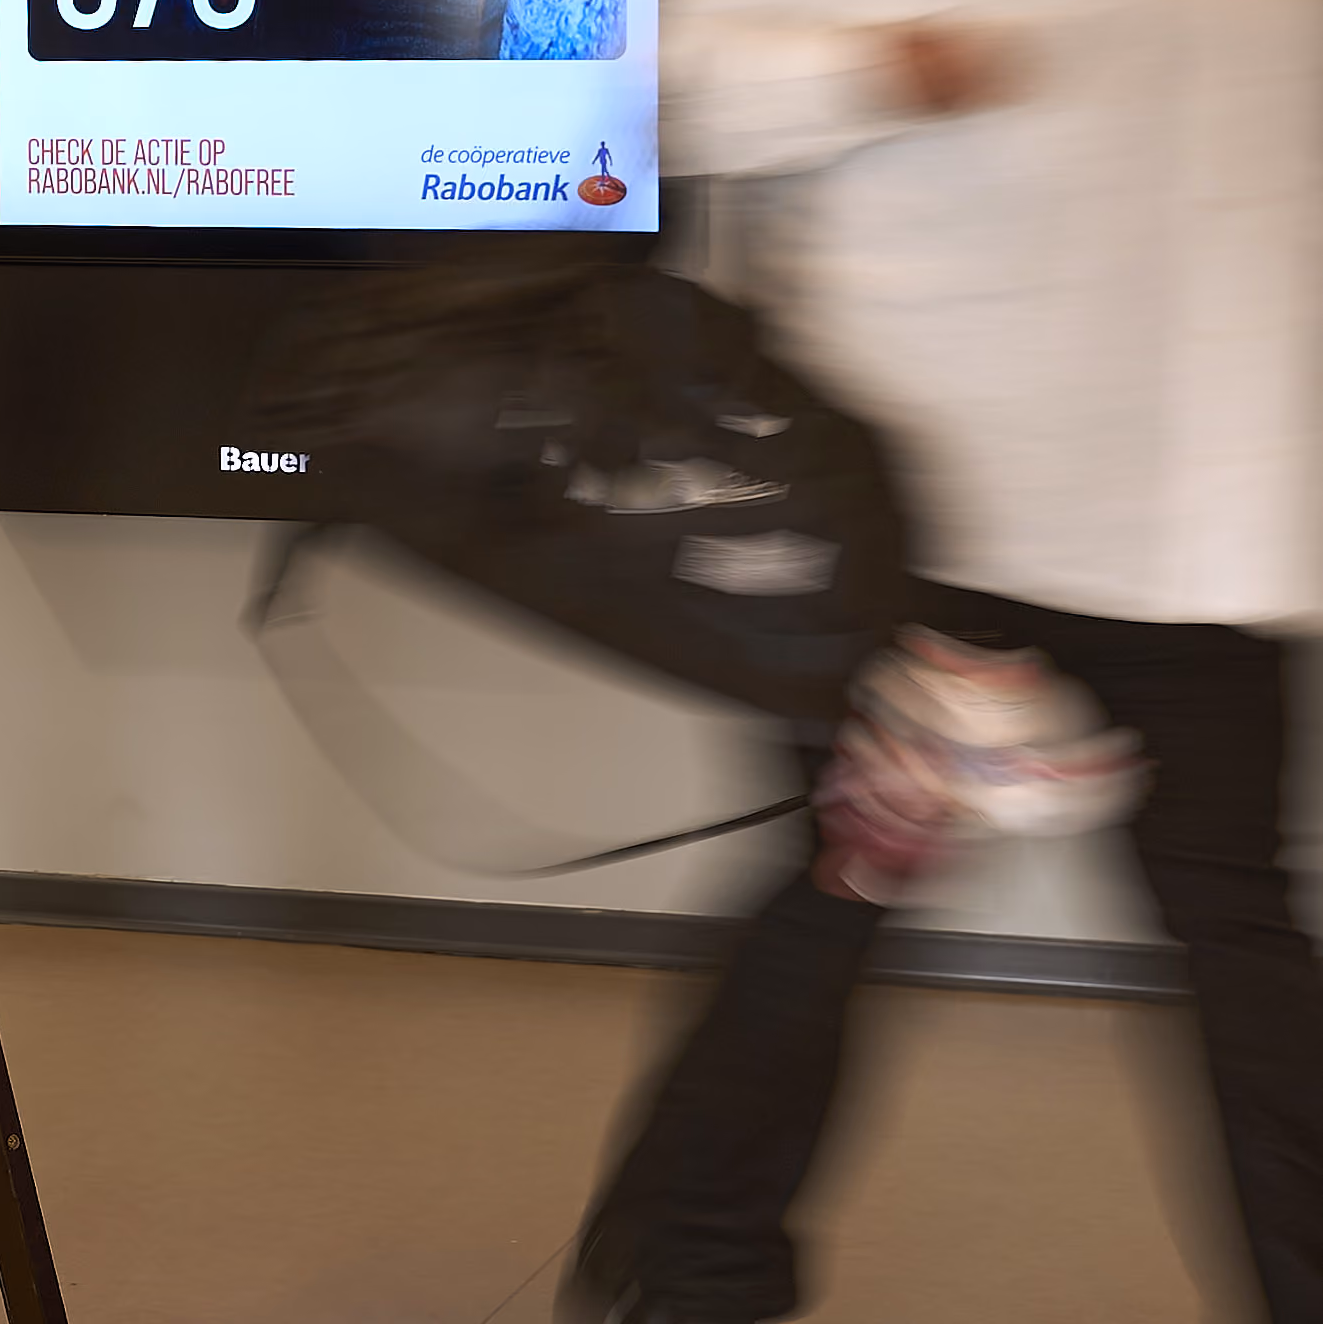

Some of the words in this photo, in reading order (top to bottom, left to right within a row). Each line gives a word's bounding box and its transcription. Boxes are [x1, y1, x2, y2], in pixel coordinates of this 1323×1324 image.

[27, 137, 95, 166] CHECK
[100, 138, 127, 166] DE
[133, 138, 192, 167] ACTIE
[198, 138, 226, 166] OP
[420, 144, 445, 164] de
[447, 145, 571, 169] coöperatieve
[27, 166, 296, 199] RABOBANK.NL/RABOFREE
[420, 173, 571, 202] Rabobank
[219, 445, 311, 474] Bauer
